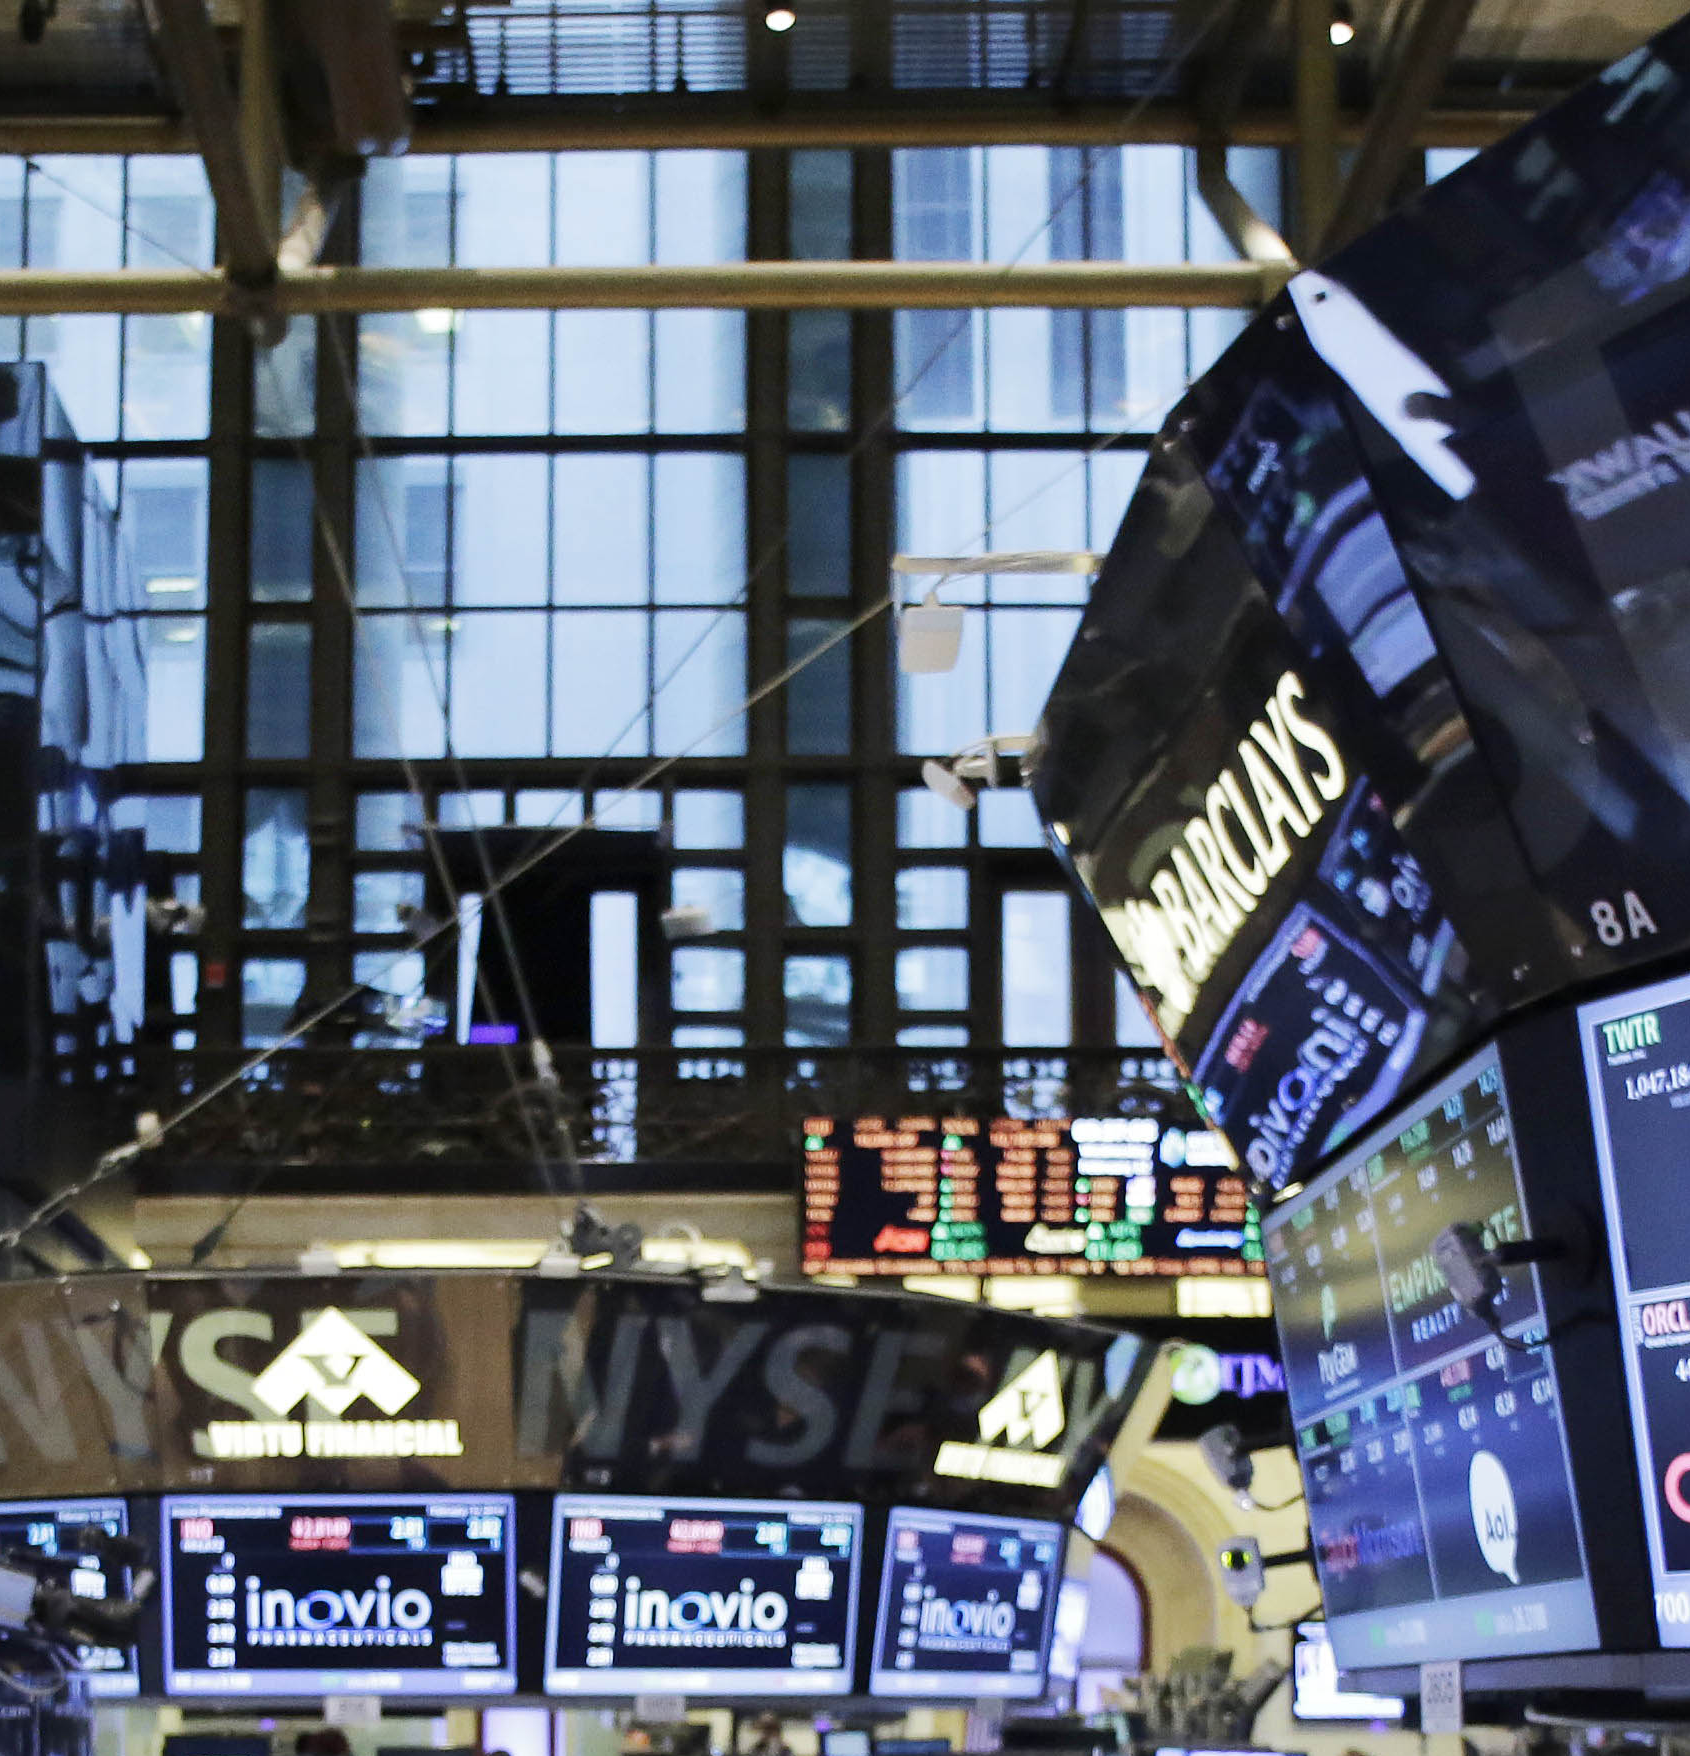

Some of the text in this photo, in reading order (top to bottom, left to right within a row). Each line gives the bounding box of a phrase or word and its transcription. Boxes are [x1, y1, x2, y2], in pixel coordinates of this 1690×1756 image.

[1150, 670, 1348, 985] BARCLAYS
[1589, 889, 1659, 947] 8A
[1602, 1010, 1663, 1054] TWTR
[1388, 1254, 1448, 1314] EMPIR
[306, 1418, 465, 1458] FINANCIAL
[245, 1574, 434, 1621] inovio
[623, 1575, 789, 1632] inovio
[919, 1584, 1016, 1638] inovio
[246, 1629, 433, 1647] PHARMACEUTICALS
